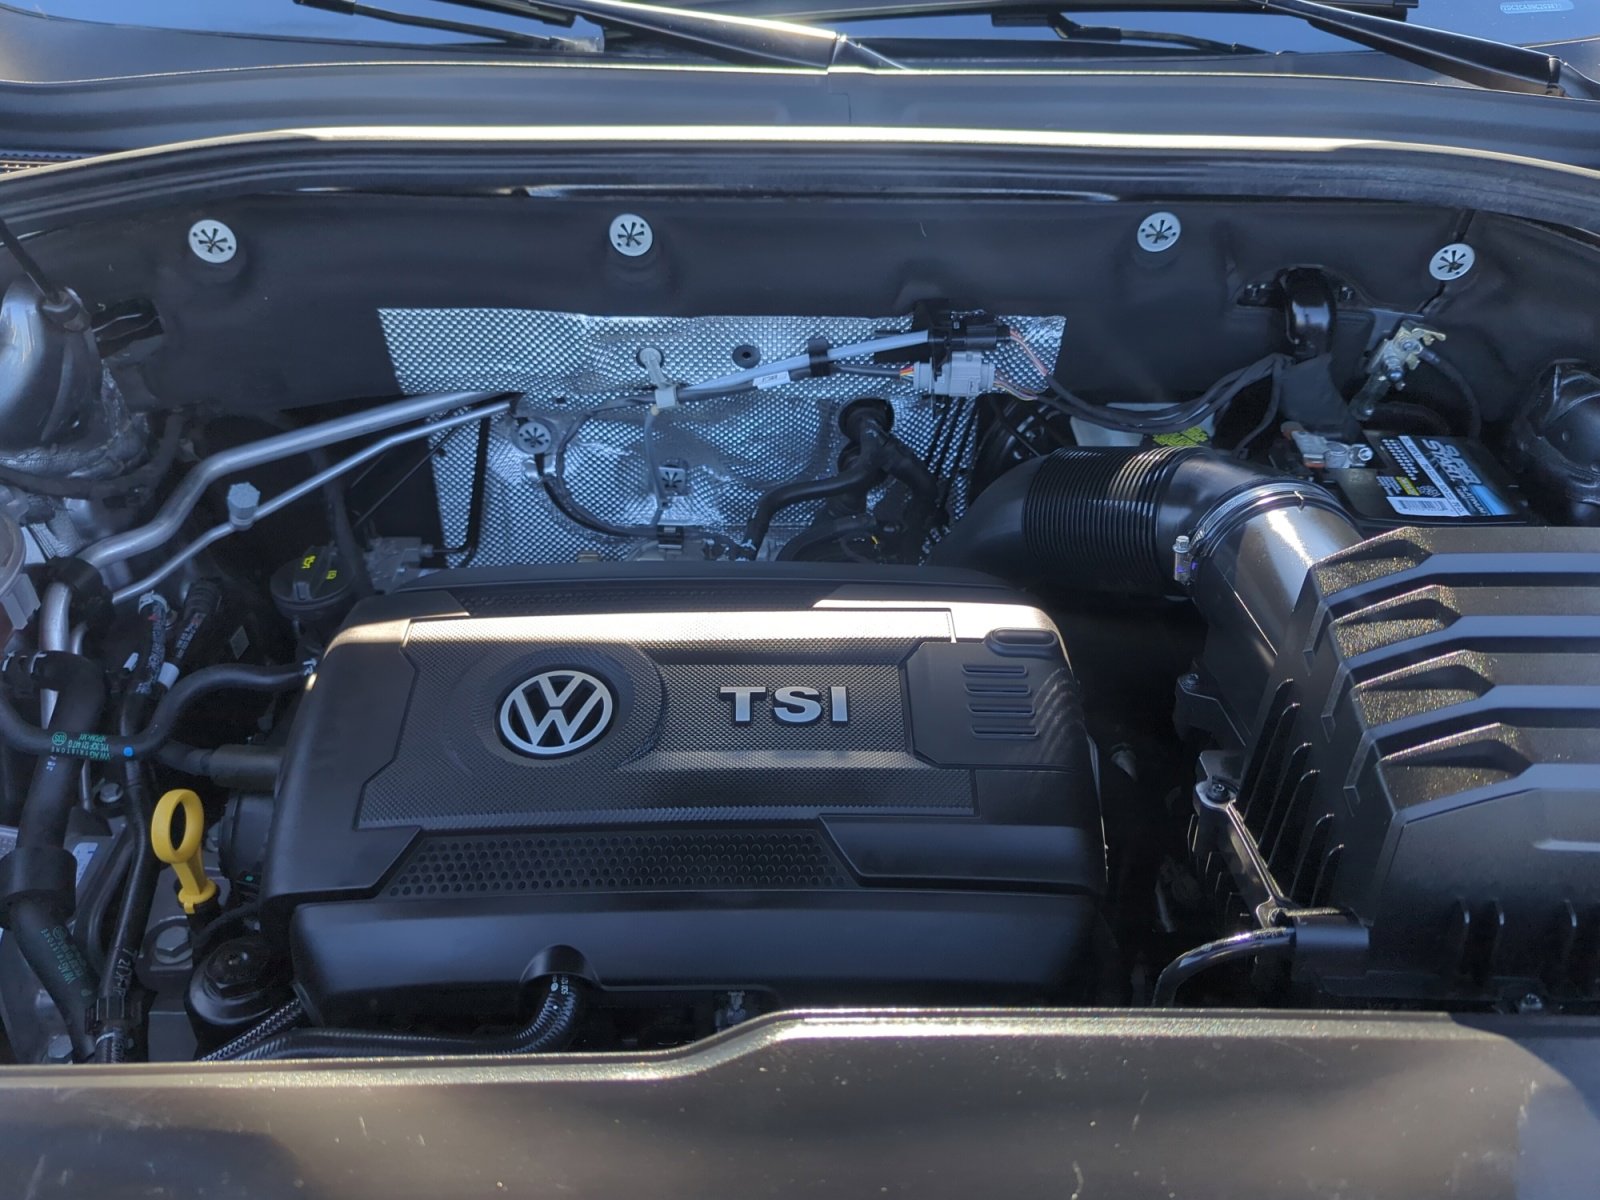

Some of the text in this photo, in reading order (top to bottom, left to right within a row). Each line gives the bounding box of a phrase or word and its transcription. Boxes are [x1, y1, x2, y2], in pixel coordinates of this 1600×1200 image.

[1421, 438, 1461, 482] START
[1443, 443, 1482, 486] SUPER
[719, 686, 849, 723] TSI
